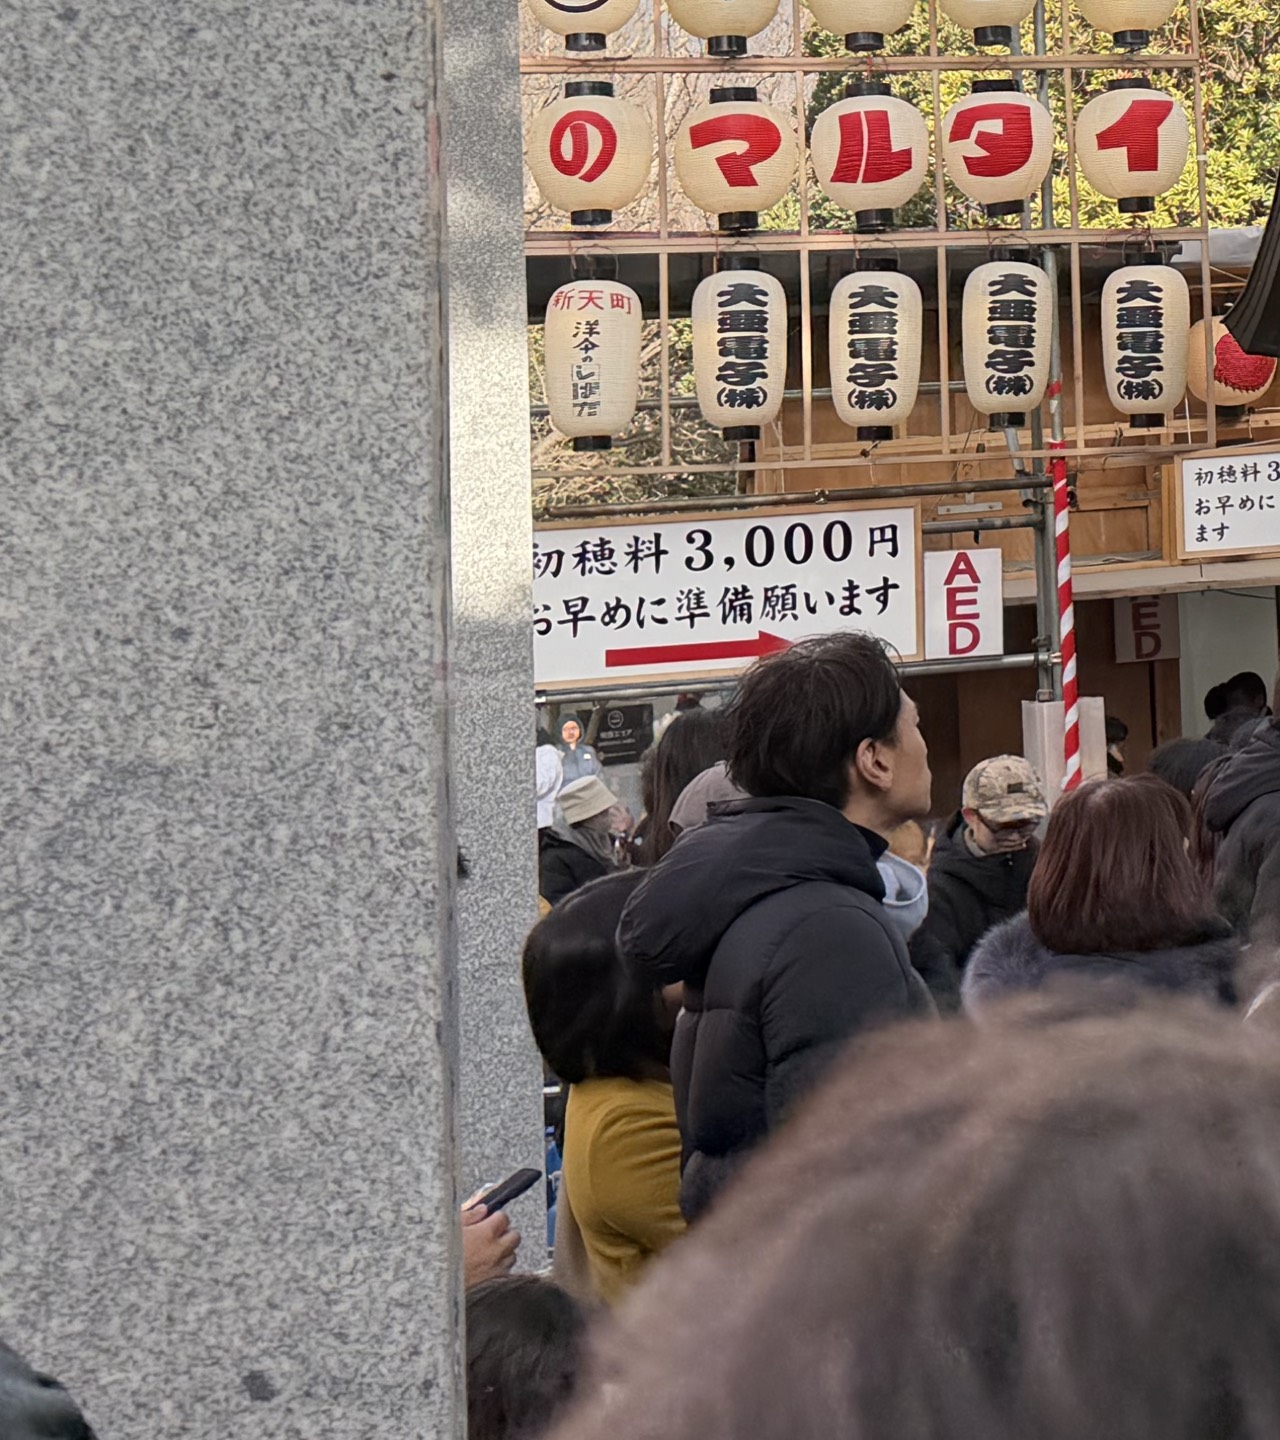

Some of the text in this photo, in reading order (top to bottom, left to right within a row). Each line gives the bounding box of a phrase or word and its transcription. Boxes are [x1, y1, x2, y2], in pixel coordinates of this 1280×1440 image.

[552, 289, 632, 314] 新天町
[1195, 522, 1231, 543] ます
[943, 551, 982, 655] AED
[1130, 594, 1162, 660] ED
